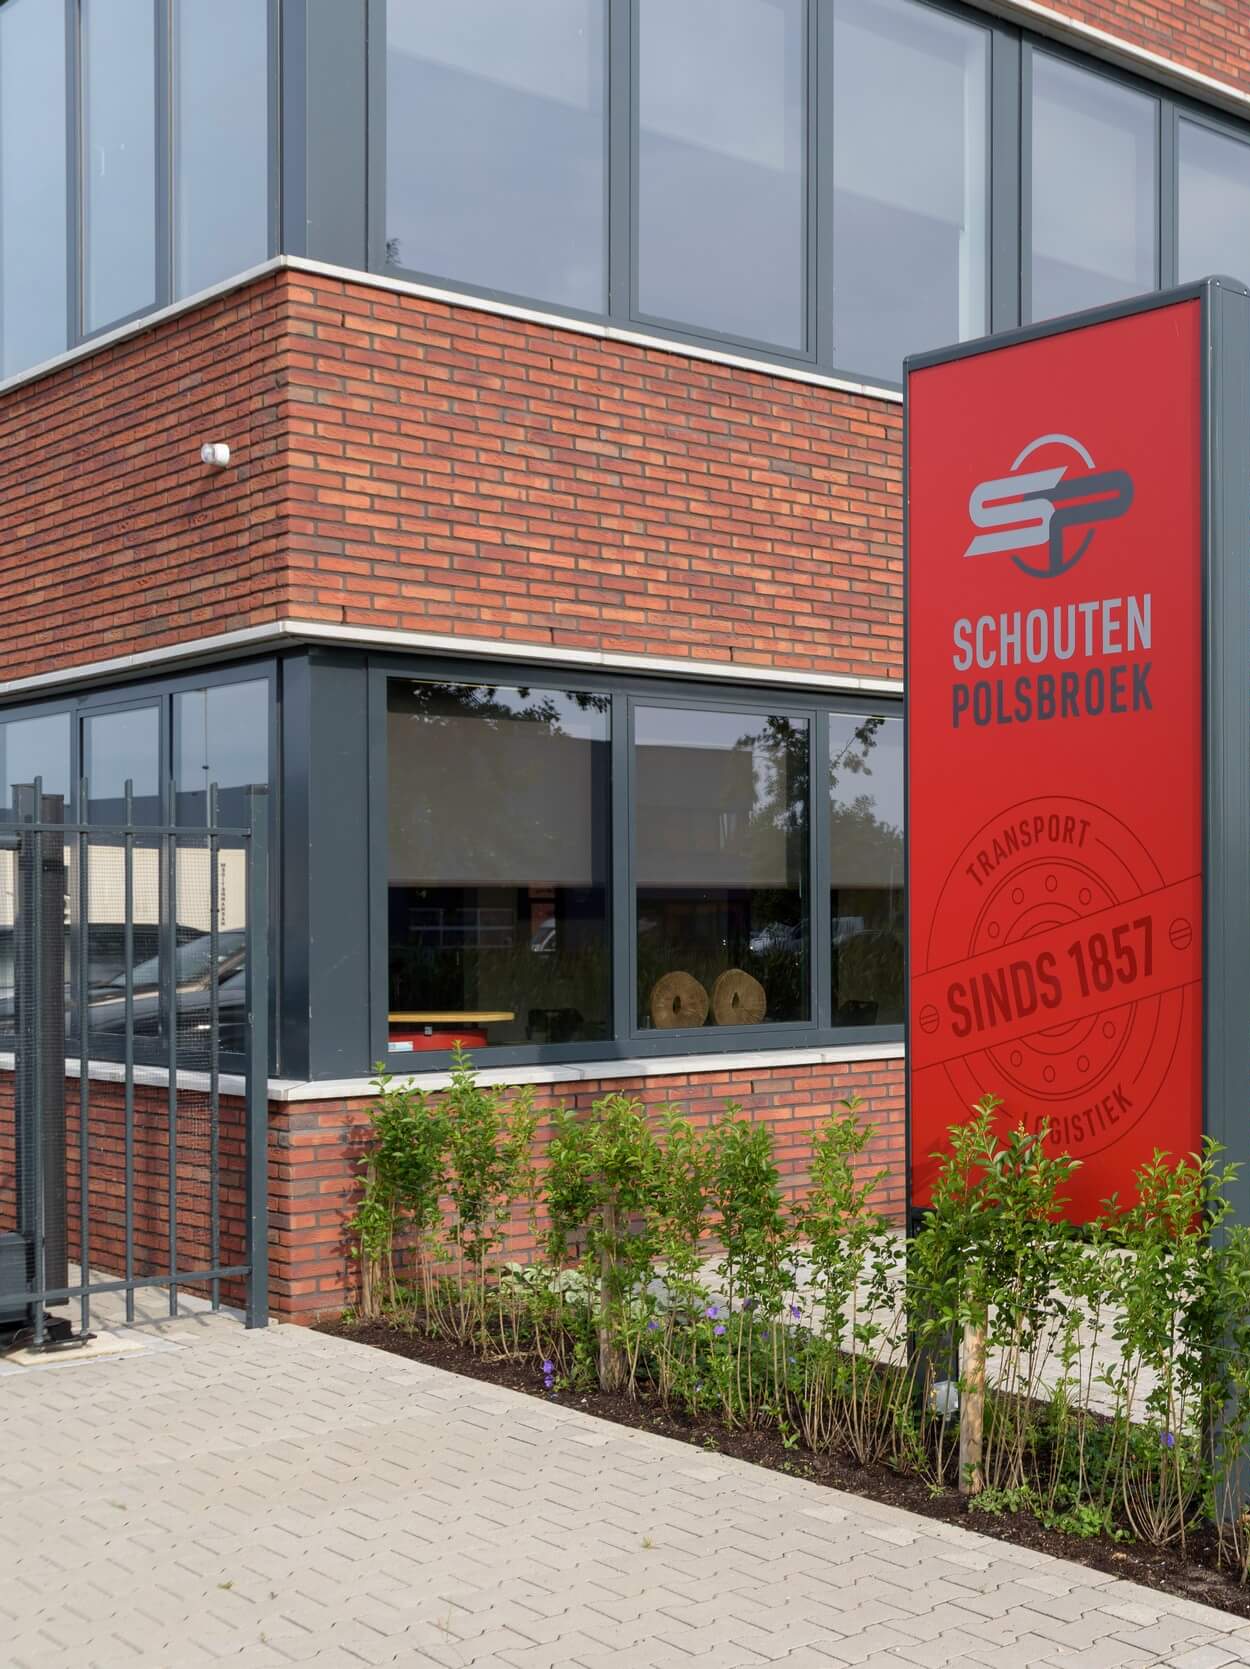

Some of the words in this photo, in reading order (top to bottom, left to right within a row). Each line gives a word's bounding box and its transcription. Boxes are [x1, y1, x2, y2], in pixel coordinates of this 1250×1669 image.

[953, 594, 1151, 671] SCHOUTEN
[952, 662, 1153, 728] POLSBROEK
[966, 814, 1091, 887] TRANSPORT
[946, 951, 1062, 1038] SINDS
[1067, 915, 1153, 999] 1857
